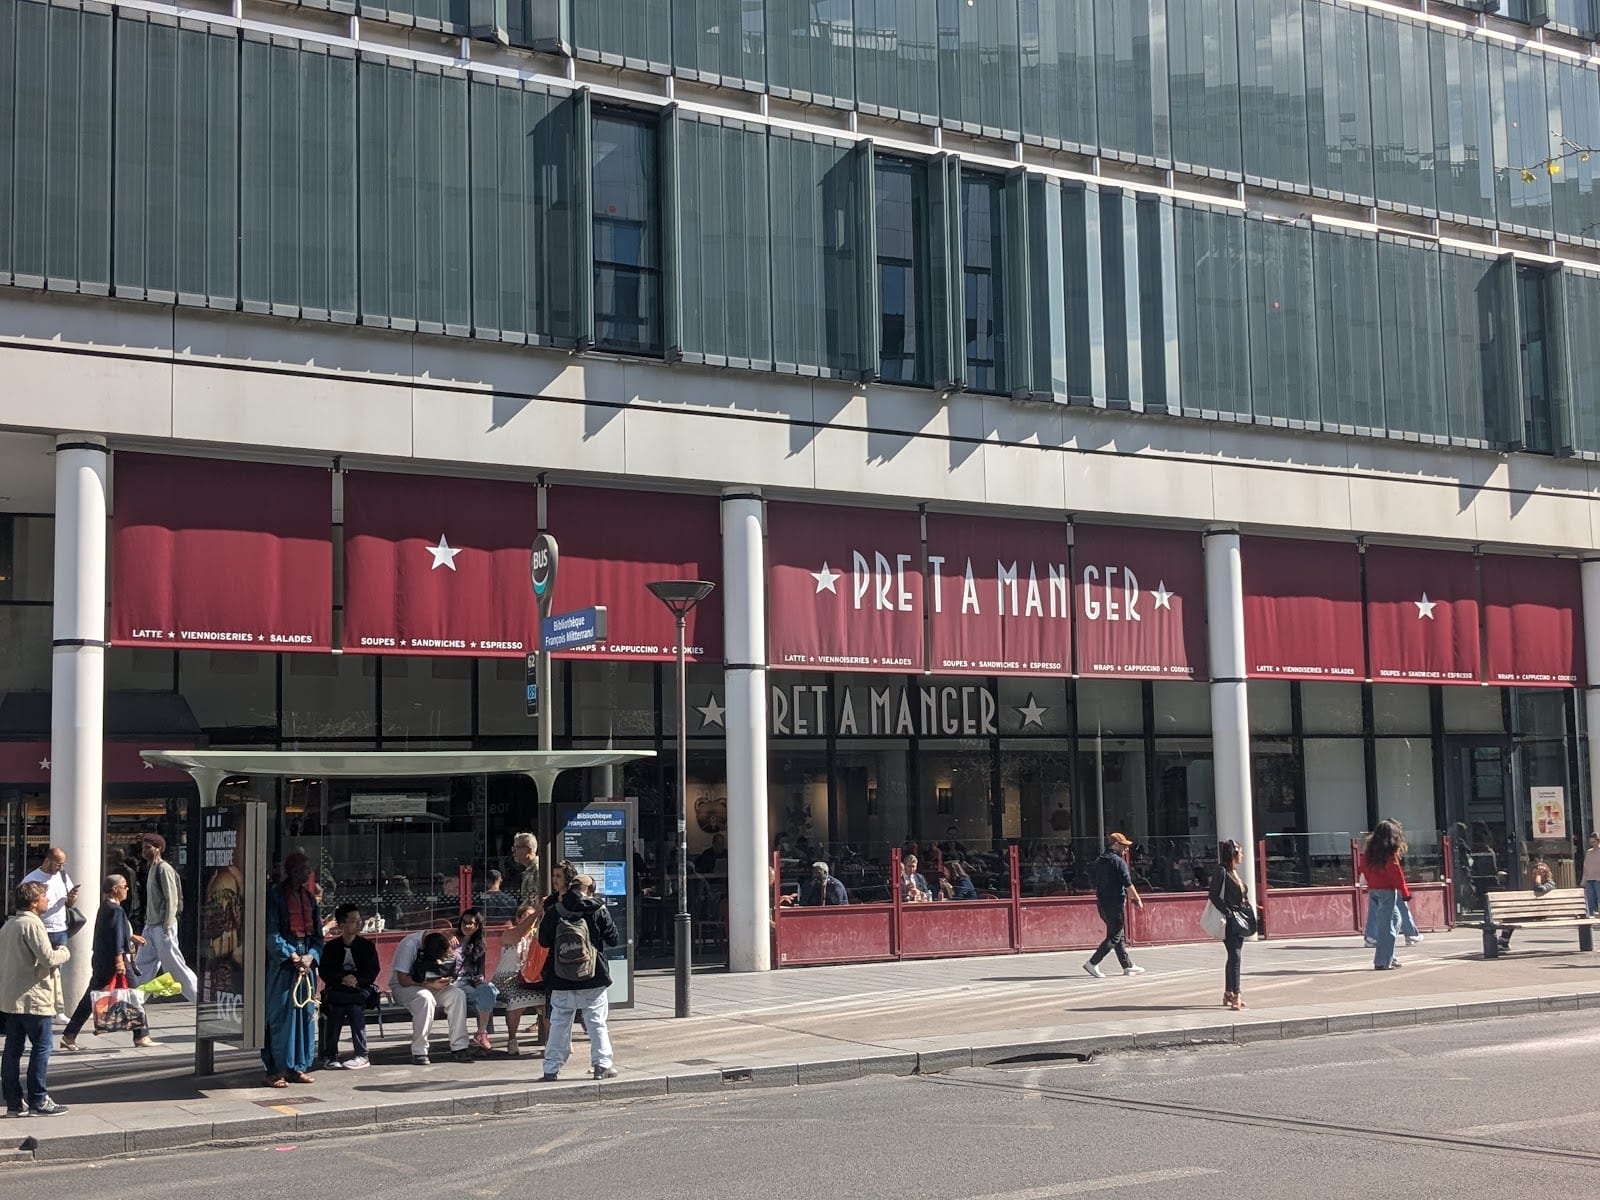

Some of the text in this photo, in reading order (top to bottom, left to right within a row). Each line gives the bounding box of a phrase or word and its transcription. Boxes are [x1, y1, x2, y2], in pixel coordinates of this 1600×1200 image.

[533, 549, 548, 570] BUS
[962, 556, 981, 615] A
[553, 616, 585, 632] Bibliothèque
[132, 629, 312, 643] LATTE VIENNOISERIES SALADES
[545, 627, 594, 647] François Mitterrand
[360, 637, 523, 649] SOUPES SANDWICHES ESPRESSO
[610, 645, 658, 654] CAPPUCCINO
[671, 647, 704, 655] COKIES
[528, 655, 536, 668] 62
[818, 656, 870, 664] VIENNOISERIES
[979, 661, 1019, 669] SANDWICHES
[528, 686, 535, 698] 89
[772, 685, 998, 735] RET A MANGER
[577, 812, 612, 820] Bibliothèque
[216, 990, 242, 1024] KFC
